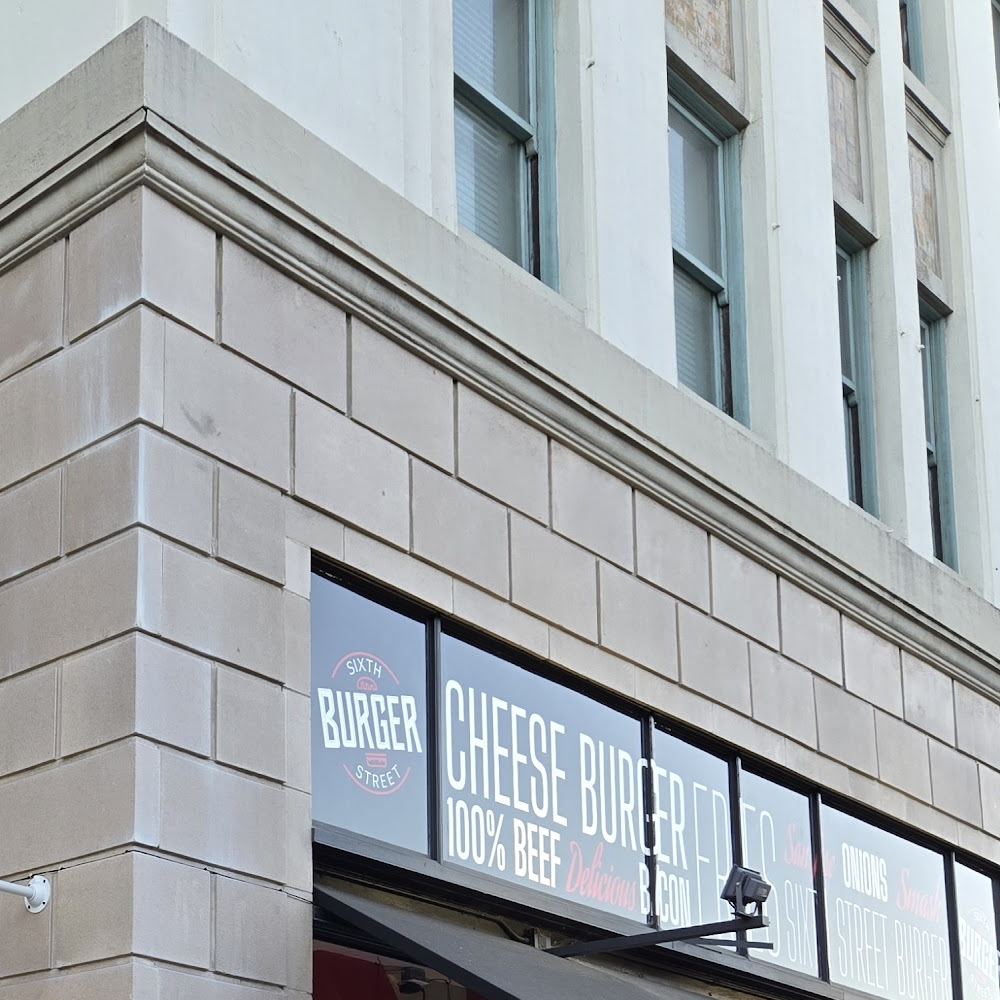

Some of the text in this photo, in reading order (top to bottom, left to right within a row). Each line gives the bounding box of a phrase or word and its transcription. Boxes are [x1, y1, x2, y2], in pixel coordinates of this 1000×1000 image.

[346, 657, 382, 679] SIXTH
[317, 687, 423, 753] BURGER
[355, 763, 402, 790] STREET
[445, 679, 568, 827] CHEESE
[579, 732, 689, 870] BURGER
[446, 797, 506, 872] 100%
[513, 819, 561, 888] BEEF
[565, 839, 638, 911] Delicious
[836, 897, 889, 991] STREET
[841, 842, 889, 903] ONIONS
[960, 915, 998, 983] BURGE
